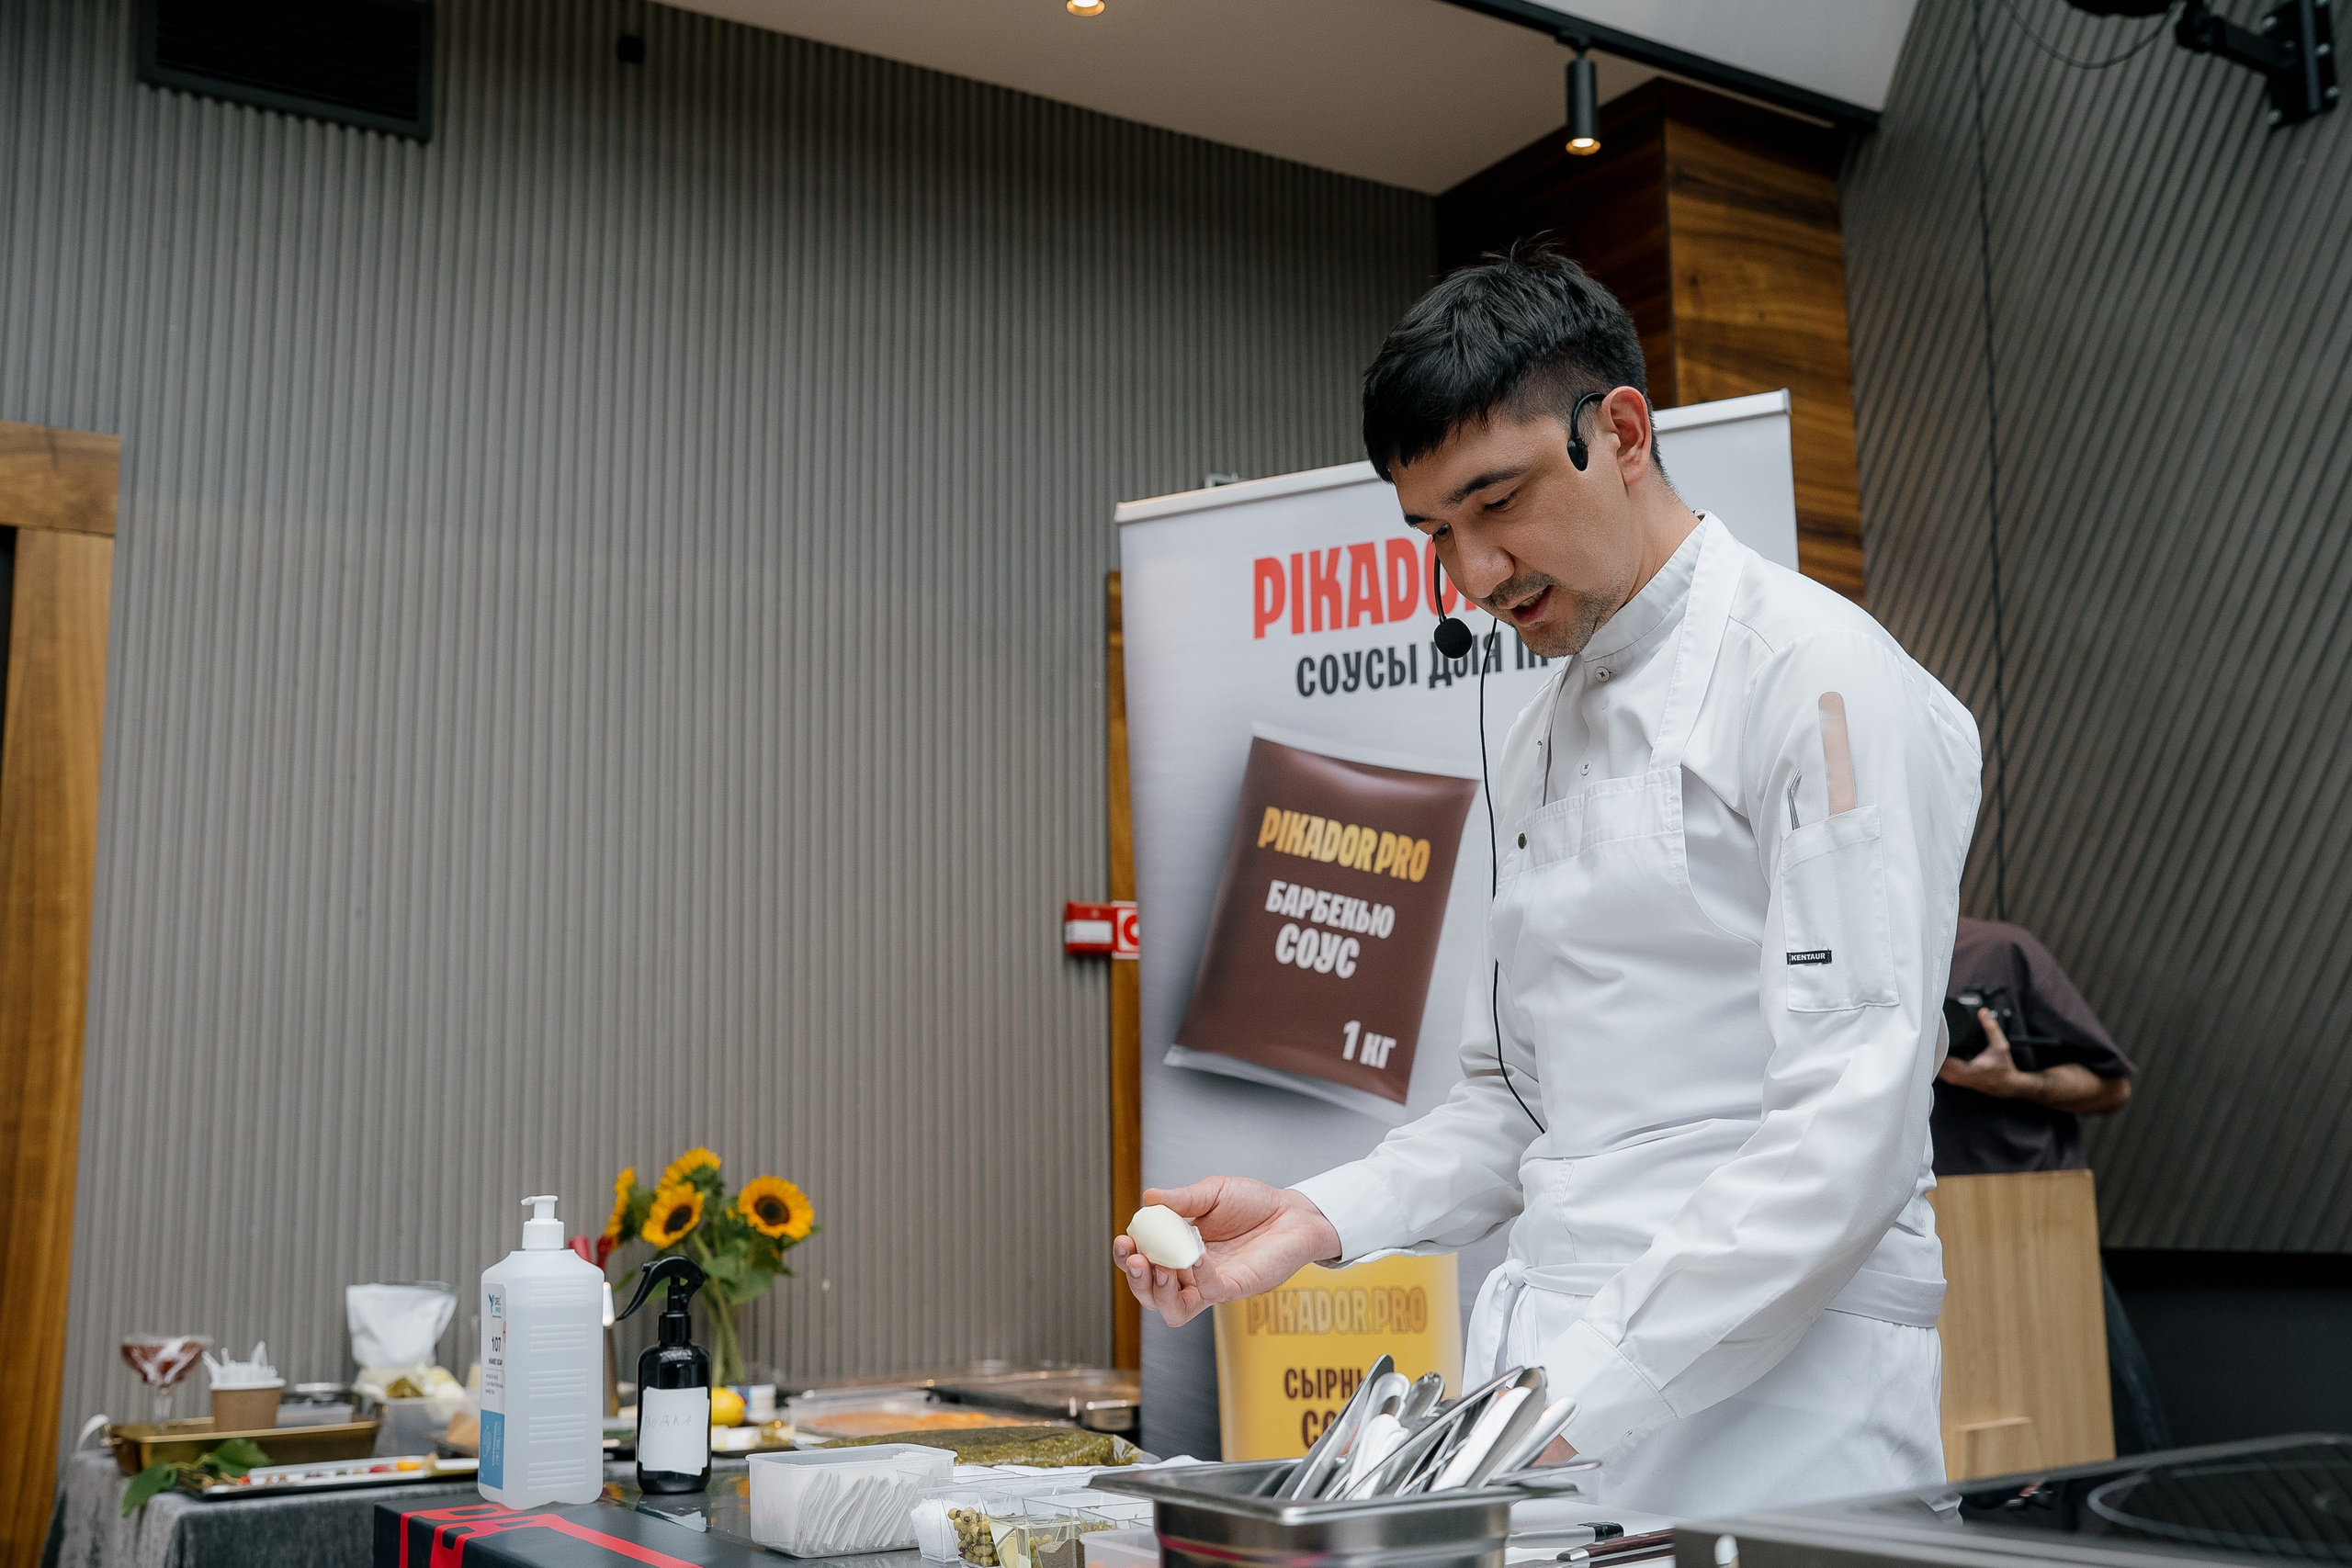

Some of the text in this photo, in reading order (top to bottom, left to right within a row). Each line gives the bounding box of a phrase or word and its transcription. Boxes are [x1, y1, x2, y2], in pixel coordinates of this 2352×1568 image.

[1254, 536, 1476, 639] PIKADO
[1296, 643, 1417, 696] СОУСЫ
[1274, 922, 1361, 979] СОУС
[1791, 953, 1826, 962] KENTAUR
[1342, 1020, 1362, 1061] 1
[492, 1337, 501, 1352] 107
